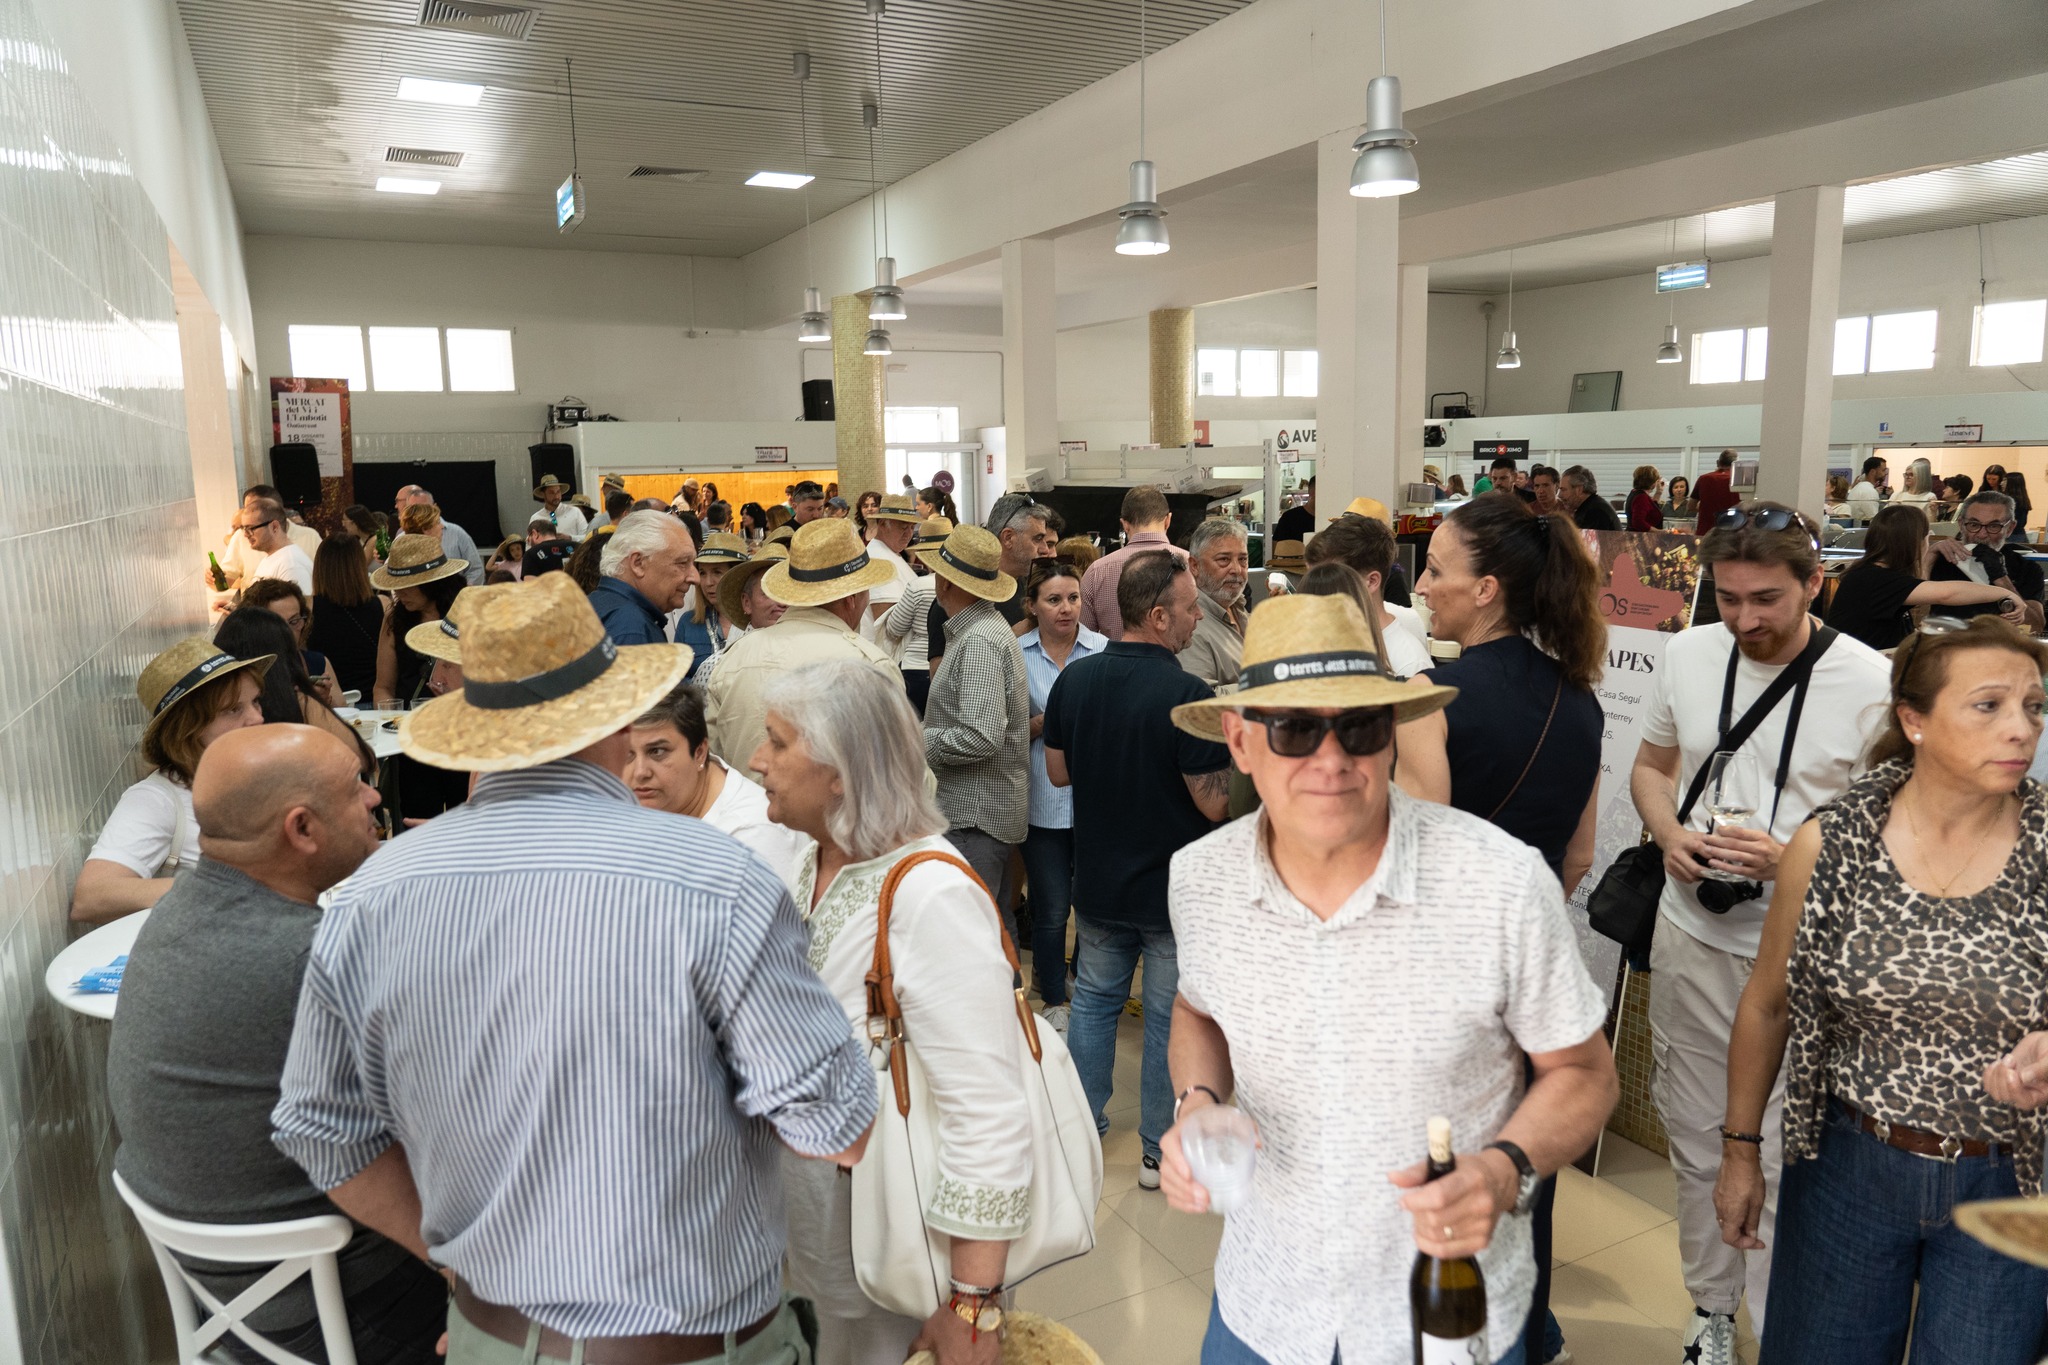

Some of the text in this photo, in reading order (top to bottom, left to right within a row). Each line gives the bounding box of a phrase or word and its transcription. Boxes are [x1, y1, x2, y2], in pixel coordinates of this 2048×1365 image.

[287, 434, 300, 443] 18
[1292, 429, 1316, 442] AVE
[1599, 593, 1628, 616] OS
[1606, 649, 1655, 674] APES
[1598, 688, 1617, 700] Casa
[1618, 691, 1642, 705] Seguí
[1602, 730, 1614, 740] US.
[1600, 764, 1613, 774] XA.
